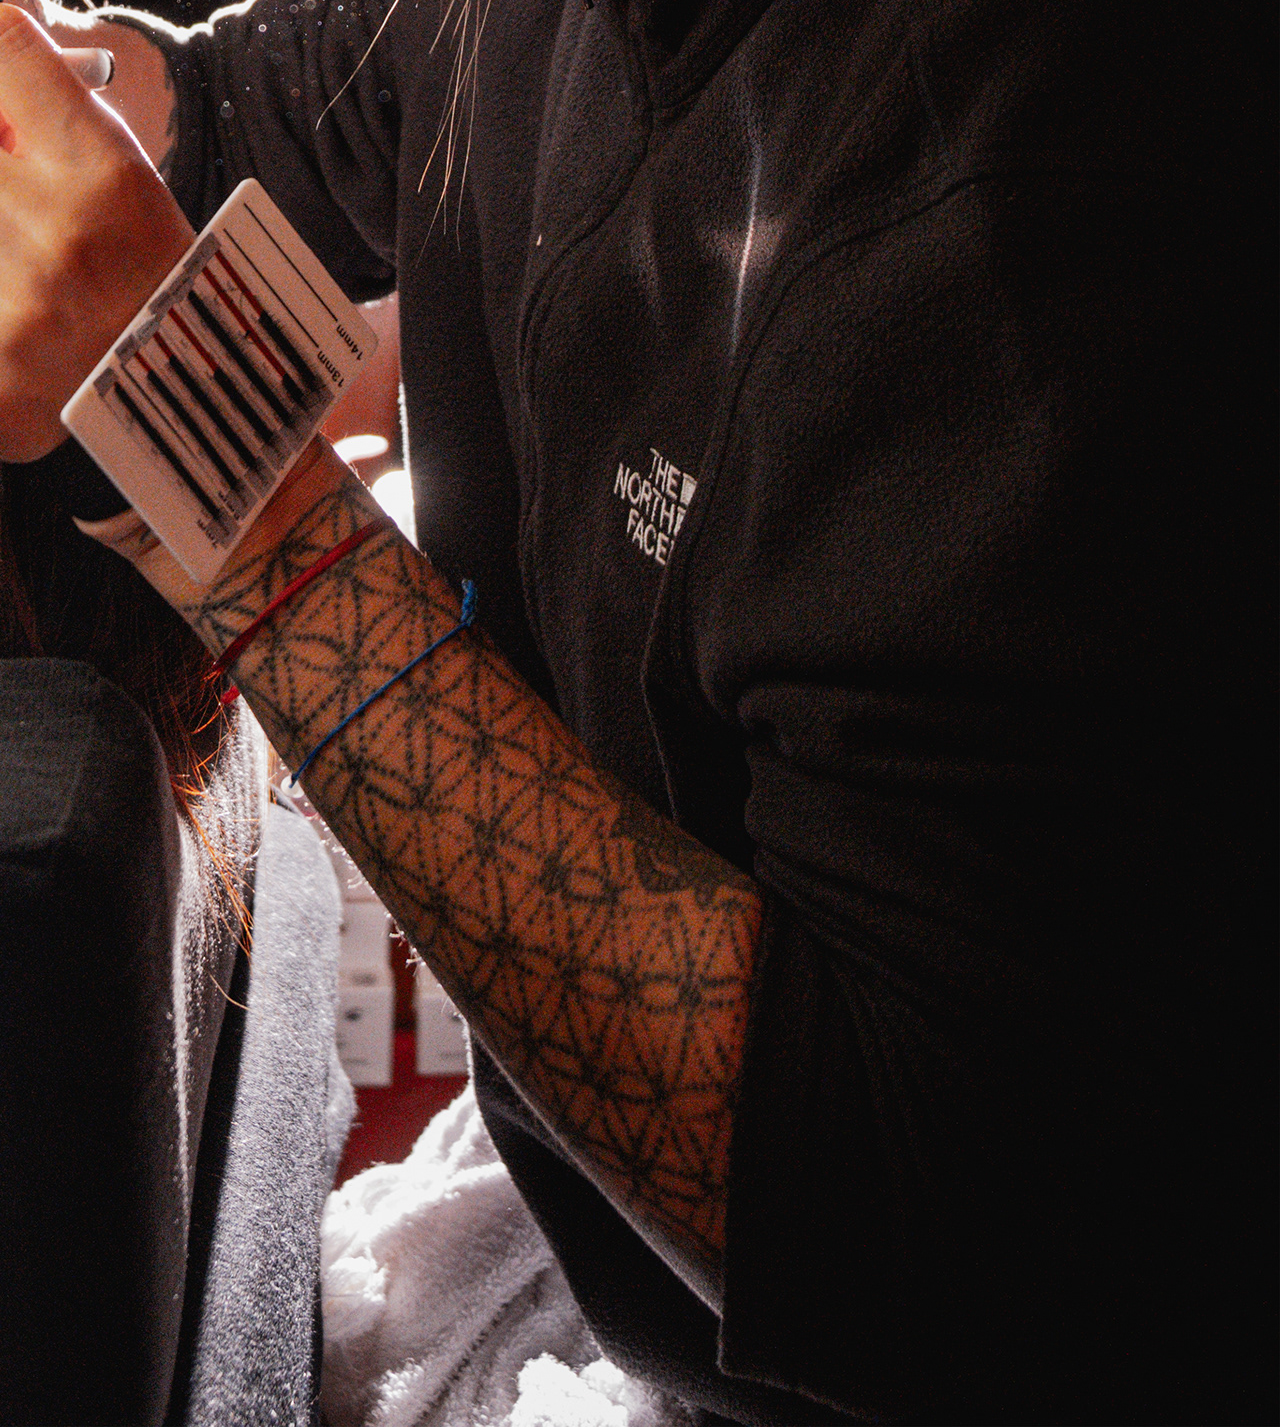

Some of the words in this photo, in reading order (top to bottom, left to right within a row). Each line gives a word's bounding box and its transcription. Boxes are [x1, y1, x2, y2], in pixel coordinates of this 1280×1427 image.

[336, 324, 363, 361] 14mm
[317, 351, 344, 388] 13mm
[613, 462, 677, 535] NORTH
[649, 447, 682, 500] THE
[626, 508, 670, 566] FACE
